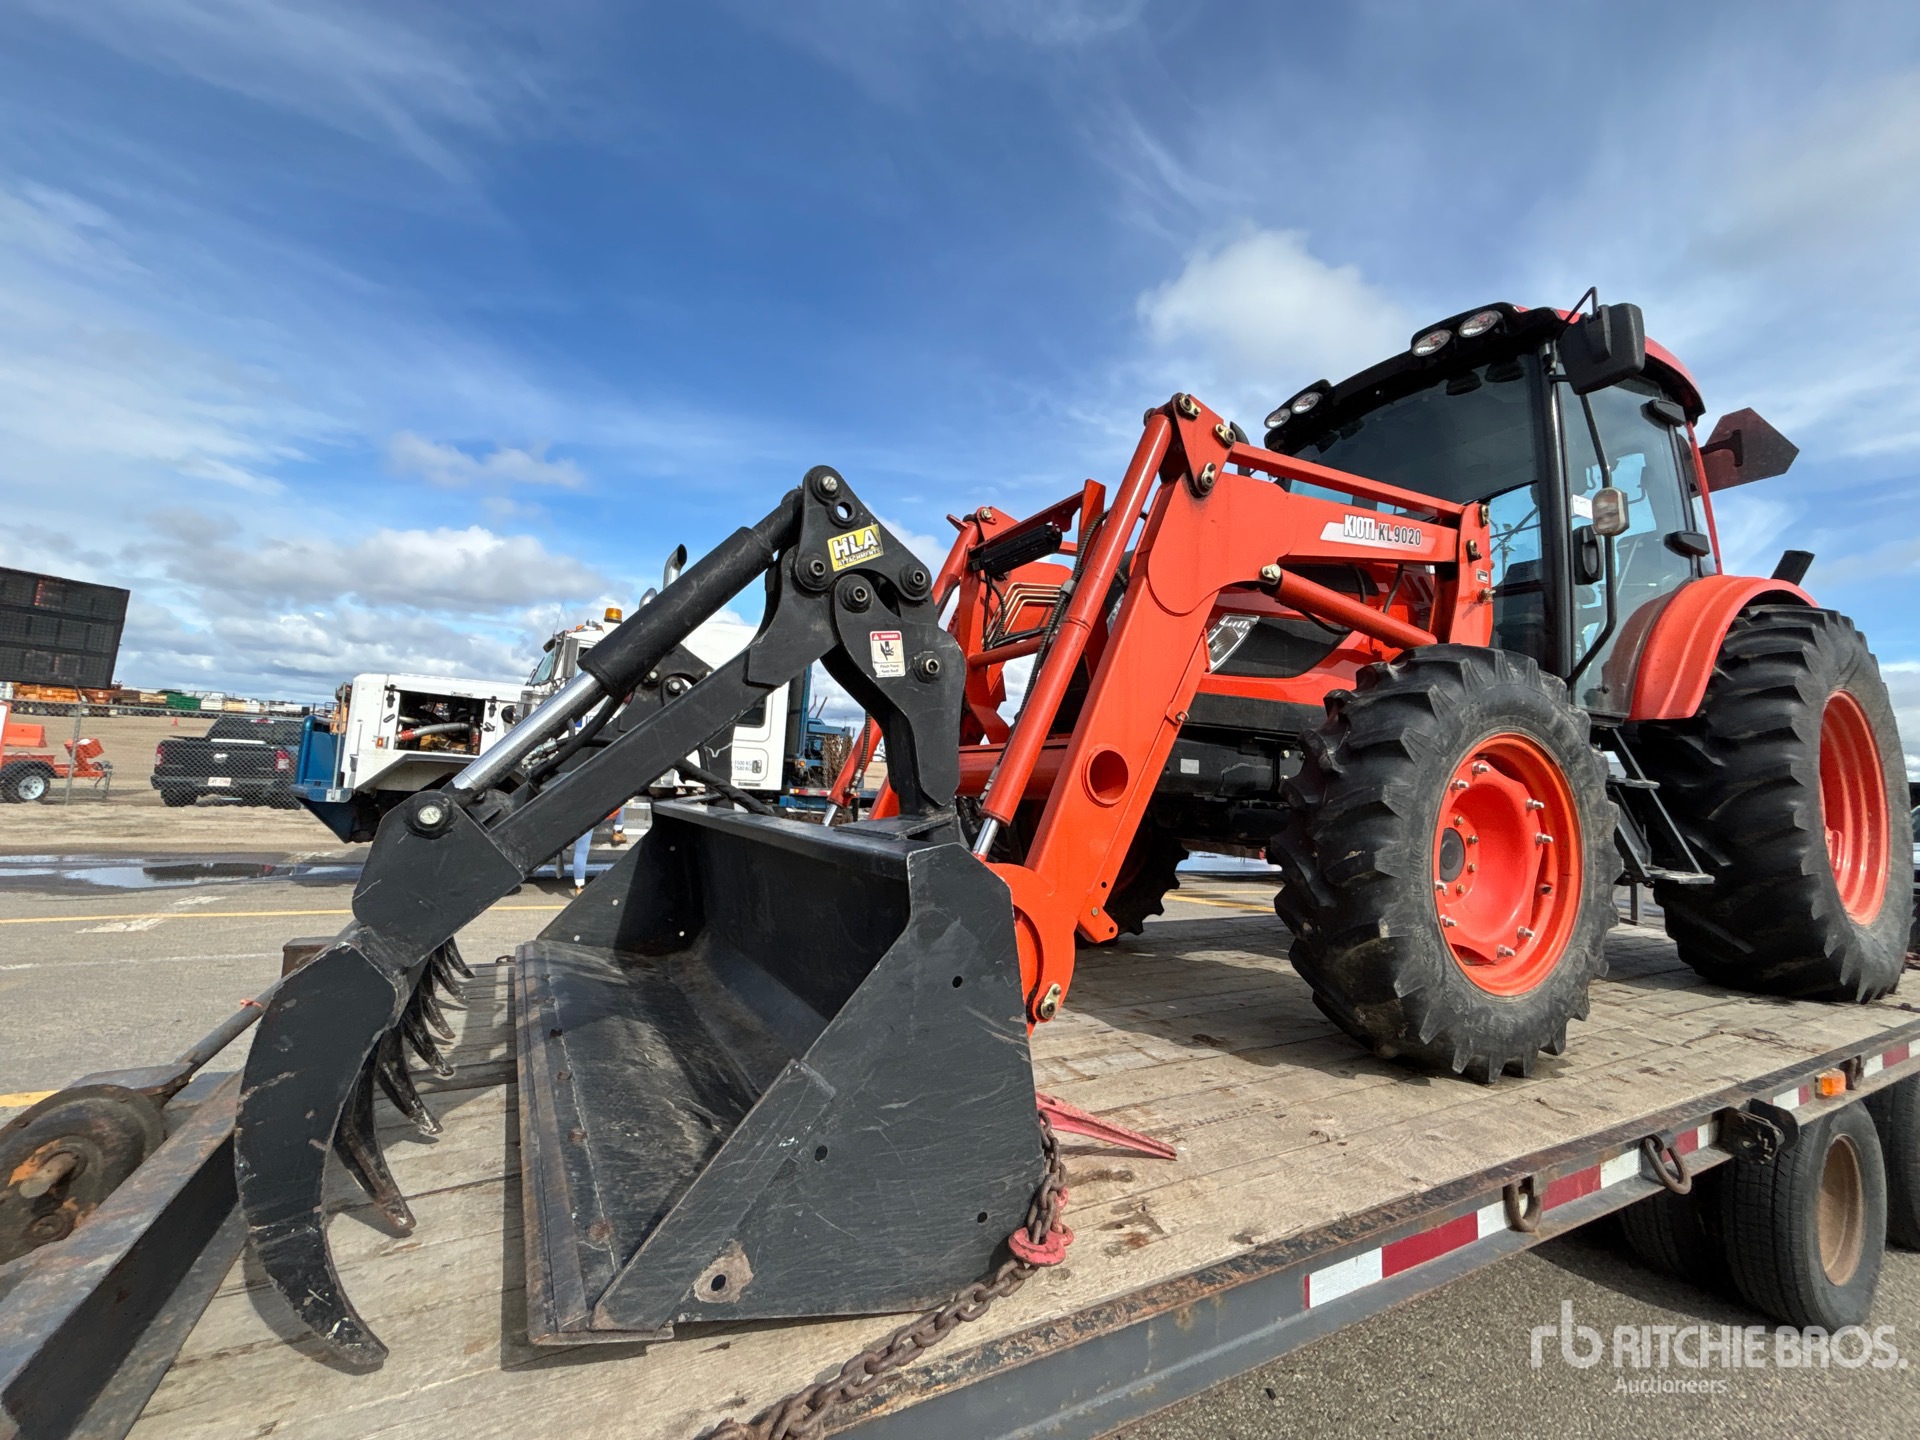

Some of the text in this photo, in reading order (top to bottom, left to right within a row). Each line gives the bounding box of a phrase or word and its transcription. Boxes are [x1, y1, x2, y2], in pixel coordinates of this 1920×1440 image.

[1343, 513, 1376, 541] KIOTI
[832, 529, 879, 560] HLA
[838, 547, 881, 567] ATTACHMENTS
